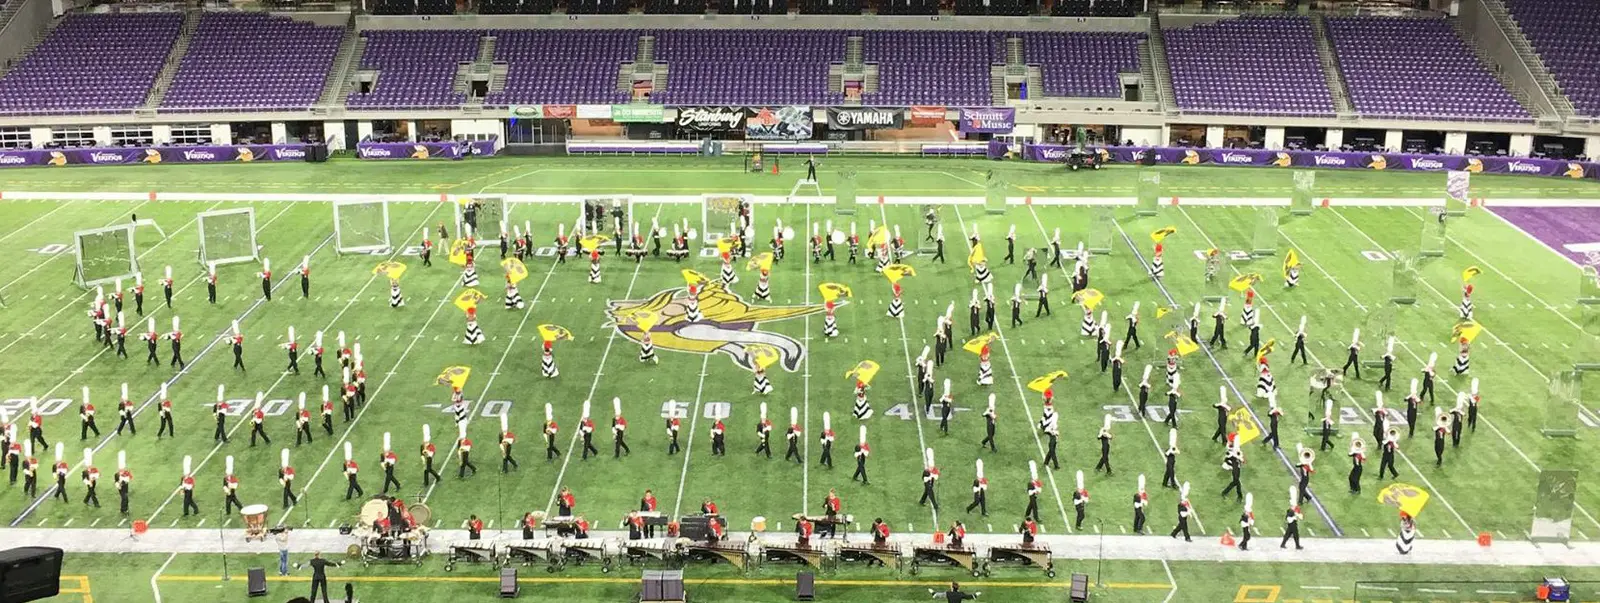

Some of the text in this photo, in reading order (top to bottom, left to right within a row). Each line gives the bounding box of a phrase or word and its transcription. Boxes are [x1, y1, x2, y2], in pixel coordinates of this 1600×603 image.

[679, 108, 743, 128] Stanbury
[850, 112, 893, 125] YAMAHA
[963, 111, 1004, 121] Schmitt
[981, 120, 1011, 129] Music
